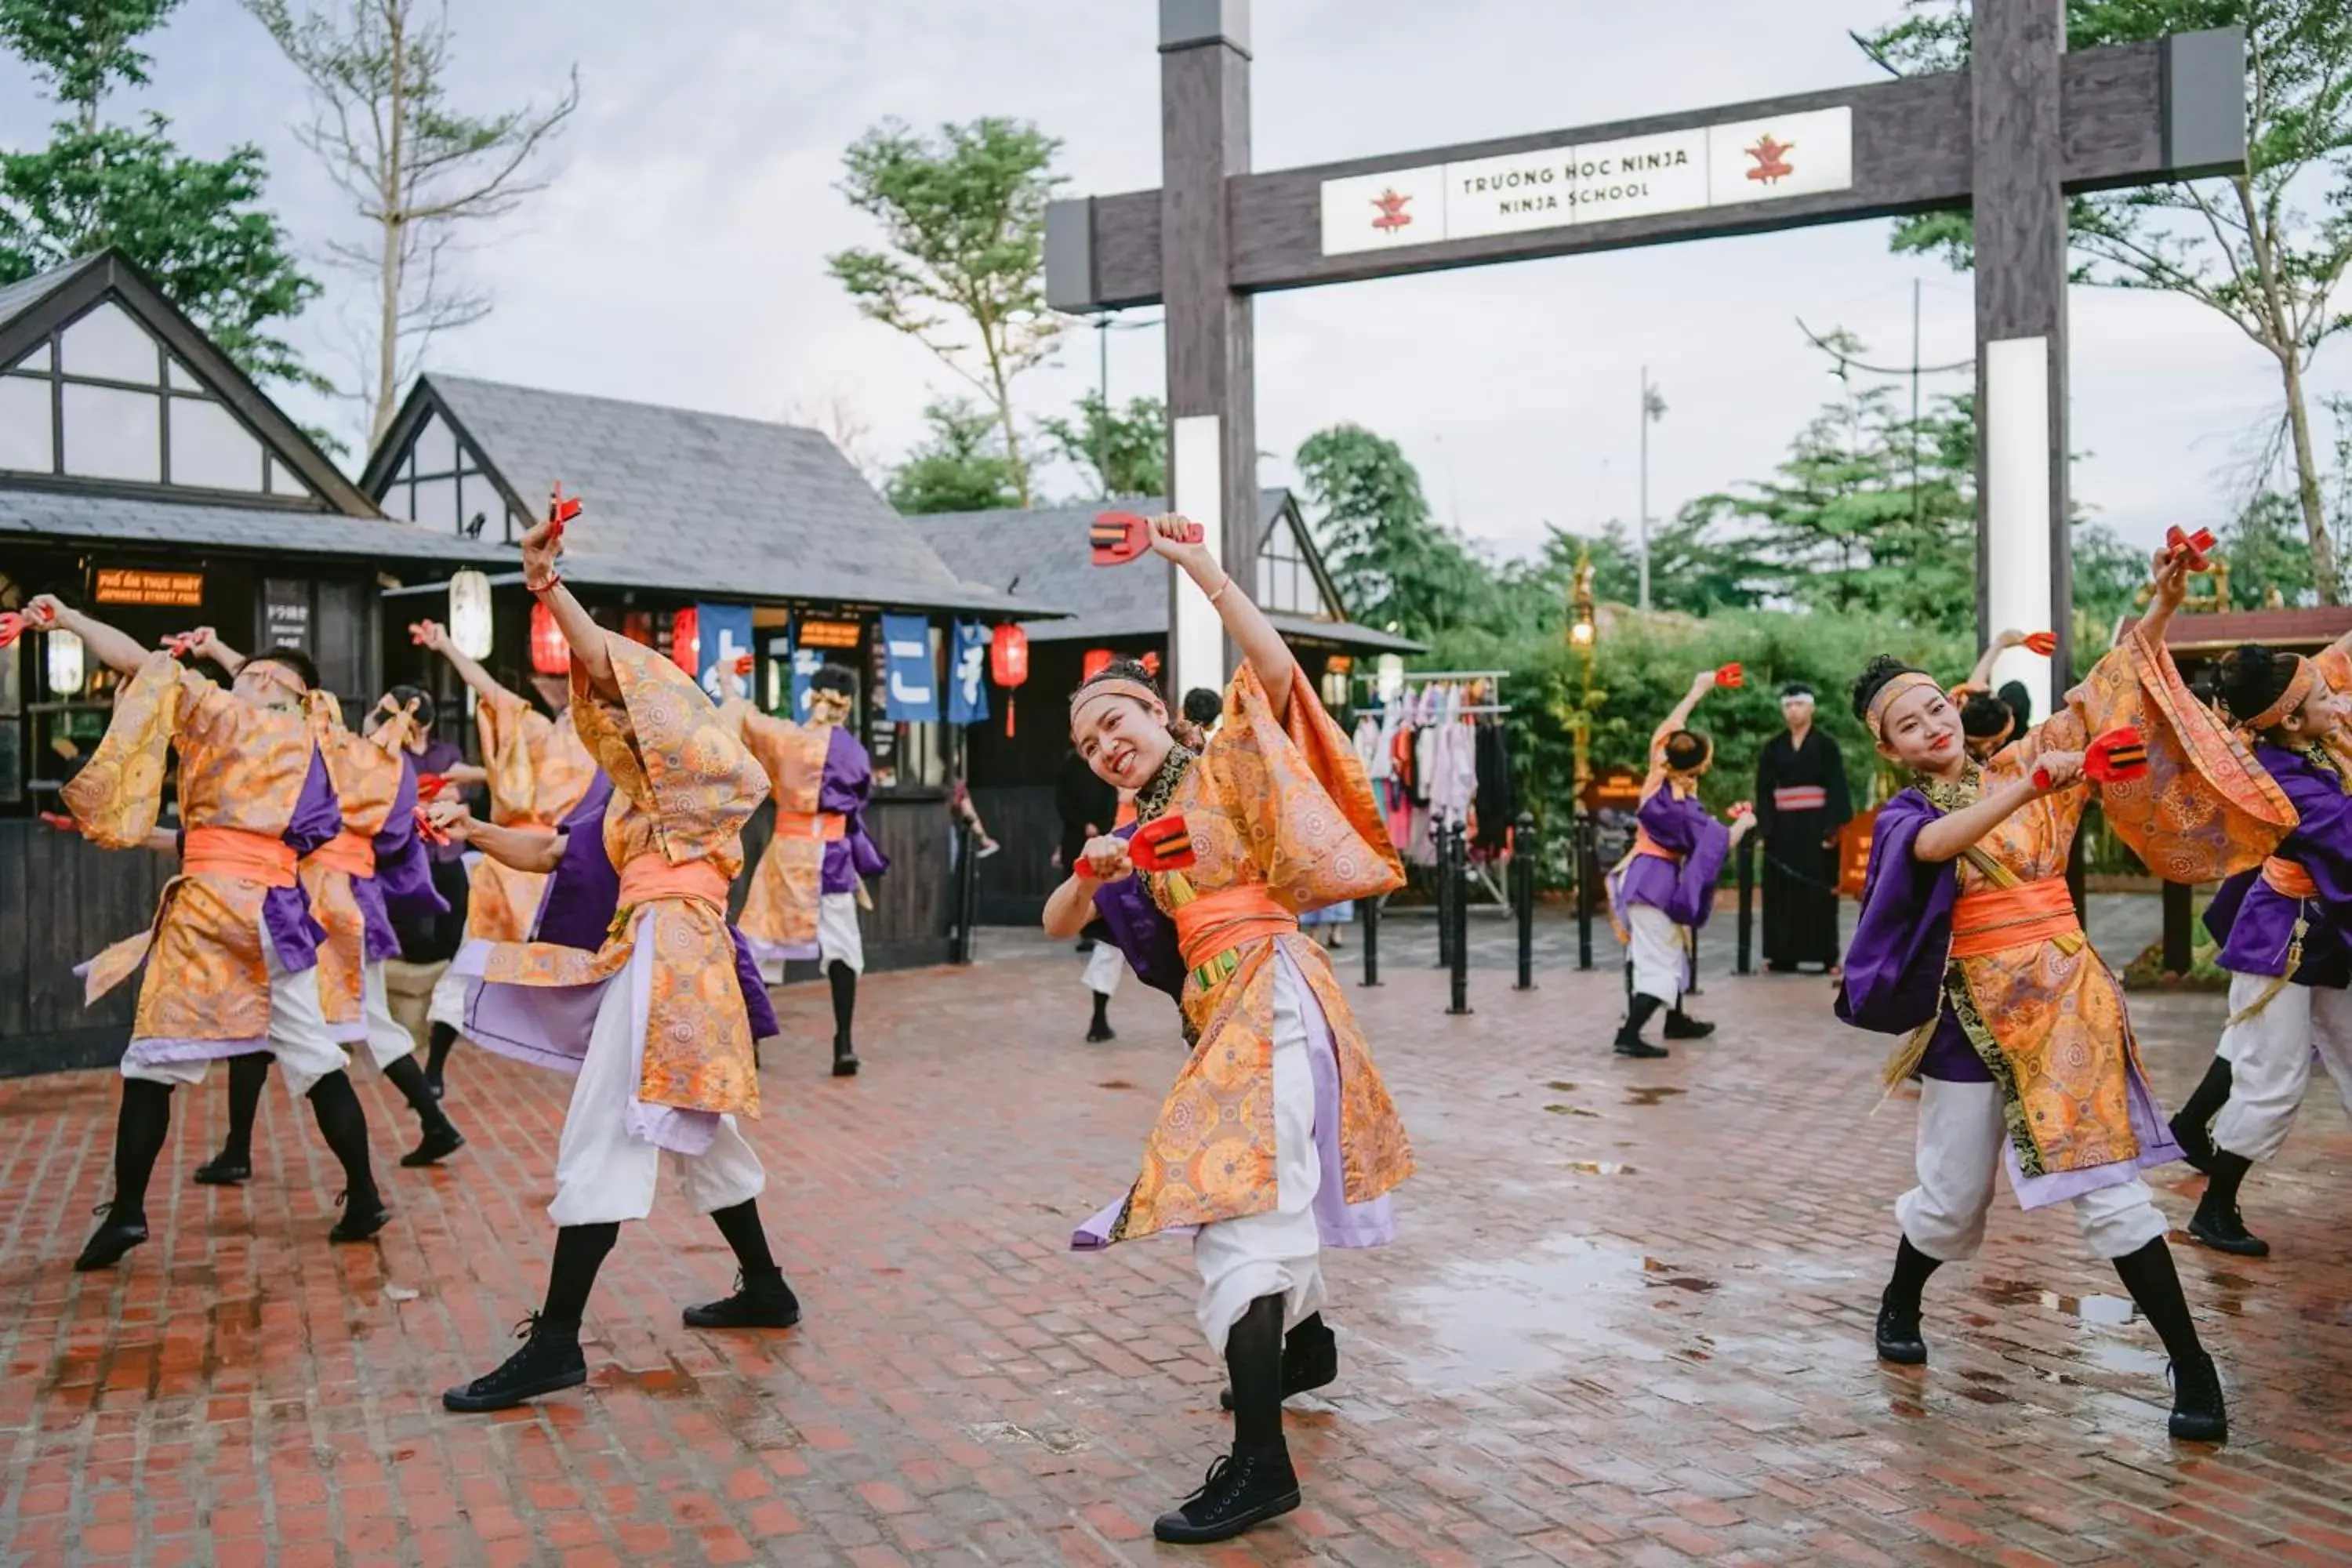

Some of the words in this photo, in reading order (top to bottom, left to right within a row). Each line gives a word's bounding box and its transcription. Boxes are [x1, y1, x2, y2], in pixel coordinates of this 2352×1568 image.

[1621, 150, 1689, 172] NINJA
[1499, 195, 1559, 215] NINJA
[1568, 183, 1650, 207] SCHOOL
